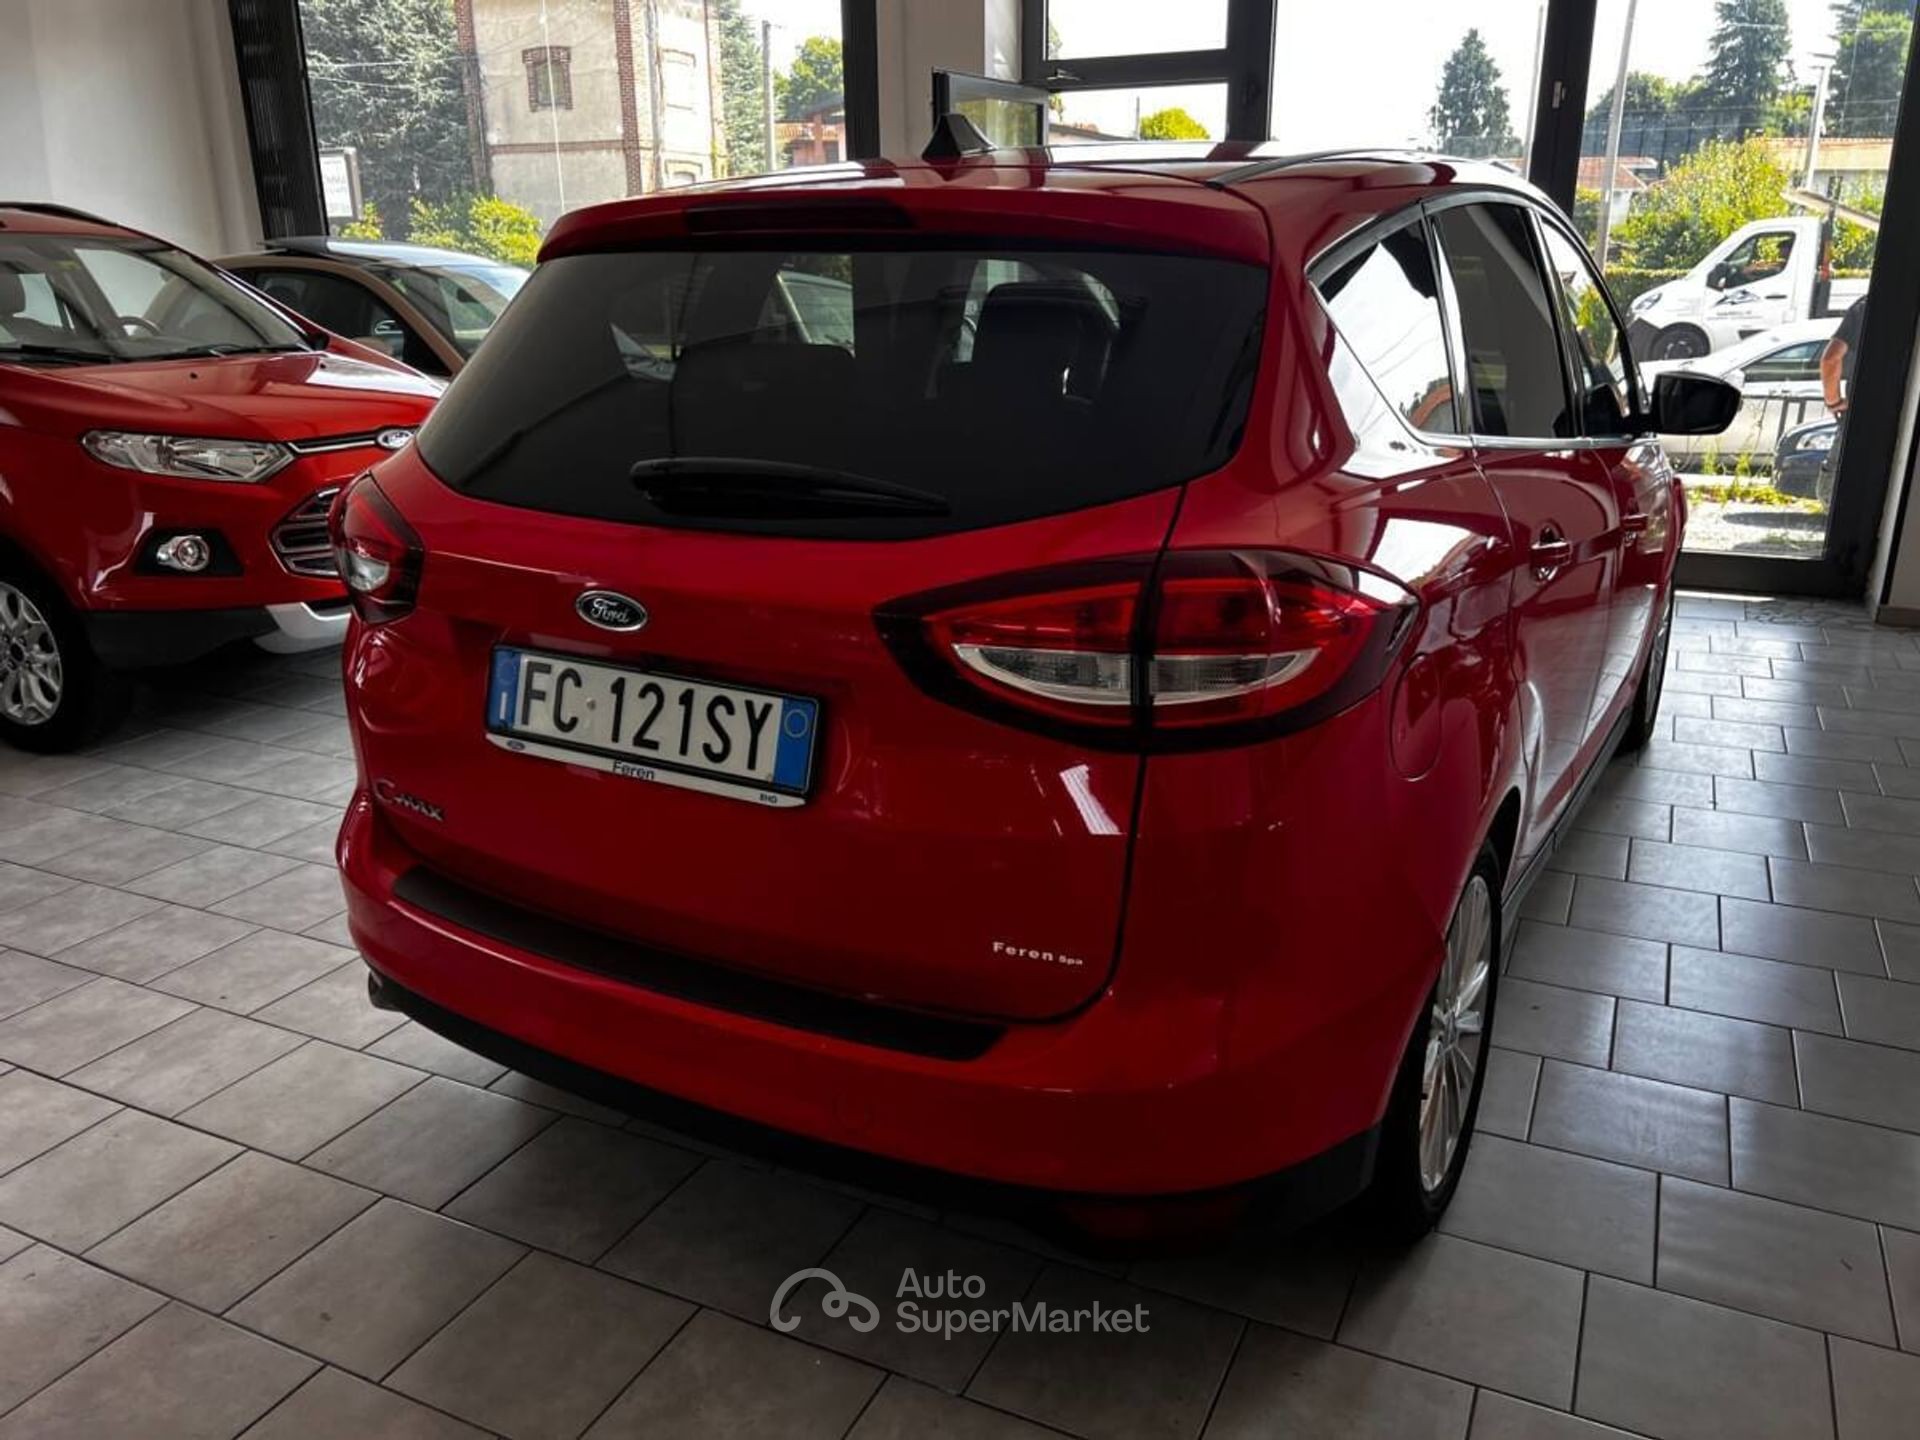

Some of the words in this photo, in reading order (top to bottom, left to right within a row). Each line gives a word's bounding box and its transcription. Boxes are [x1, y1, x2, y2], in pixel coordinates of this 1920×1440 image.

[590, 597, 630, 625] Ford
[521, 660, 583, 734] FC
[610, 676, 774, 771] 121SY
[613, 758, 655, 781] Feren
[991, 941, 1054, 962] Feren
[1058, 955, 1084, 966] Spa
